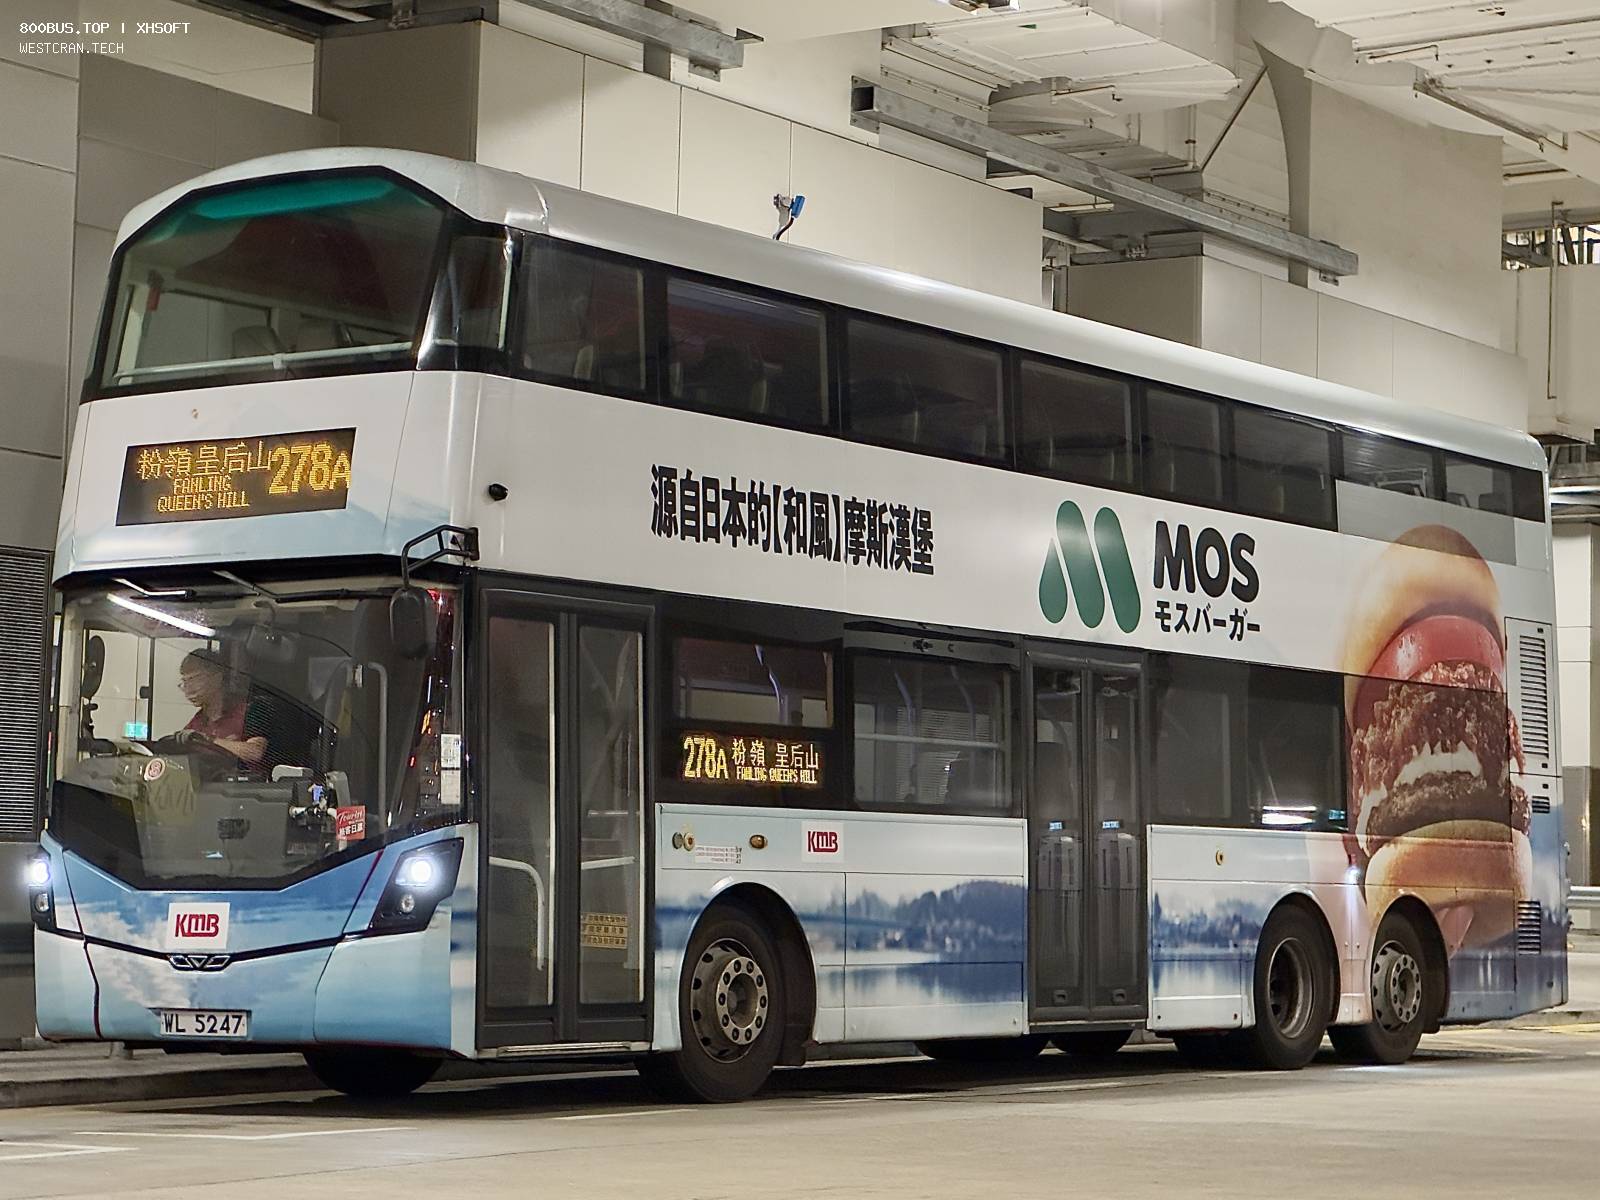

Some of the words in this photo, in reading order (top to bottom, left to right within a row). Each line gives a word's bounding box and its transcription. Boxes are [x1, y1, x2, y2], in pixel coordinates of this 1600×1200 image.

[137, 440, 272, 480] 粉嶺皇后山
[268, 441, 350, 495] 278A
[157, 493, 213, 512] QUEEN'S
[217, 490, 250, 508] HILL
[173, 474, 232, 495] FANLING
[650, 463, 934, 575] 源自日本的【和風】摩斯漢堡
[1153, 520, 1260, 603] MOS
[1155, 600, 1260, 642] モスバーガー
[682, 736, 729, 779] 278A
[732, 738, 765, 766] 粉嶺
[775, 742, 819, 769] 皇后山
[807, 830, 839, 853] KMB
[175, 913, 220, 938] KMB
[163, 1013, 186, 1033] WL
[195, 1014, 243, 1034] 5247
